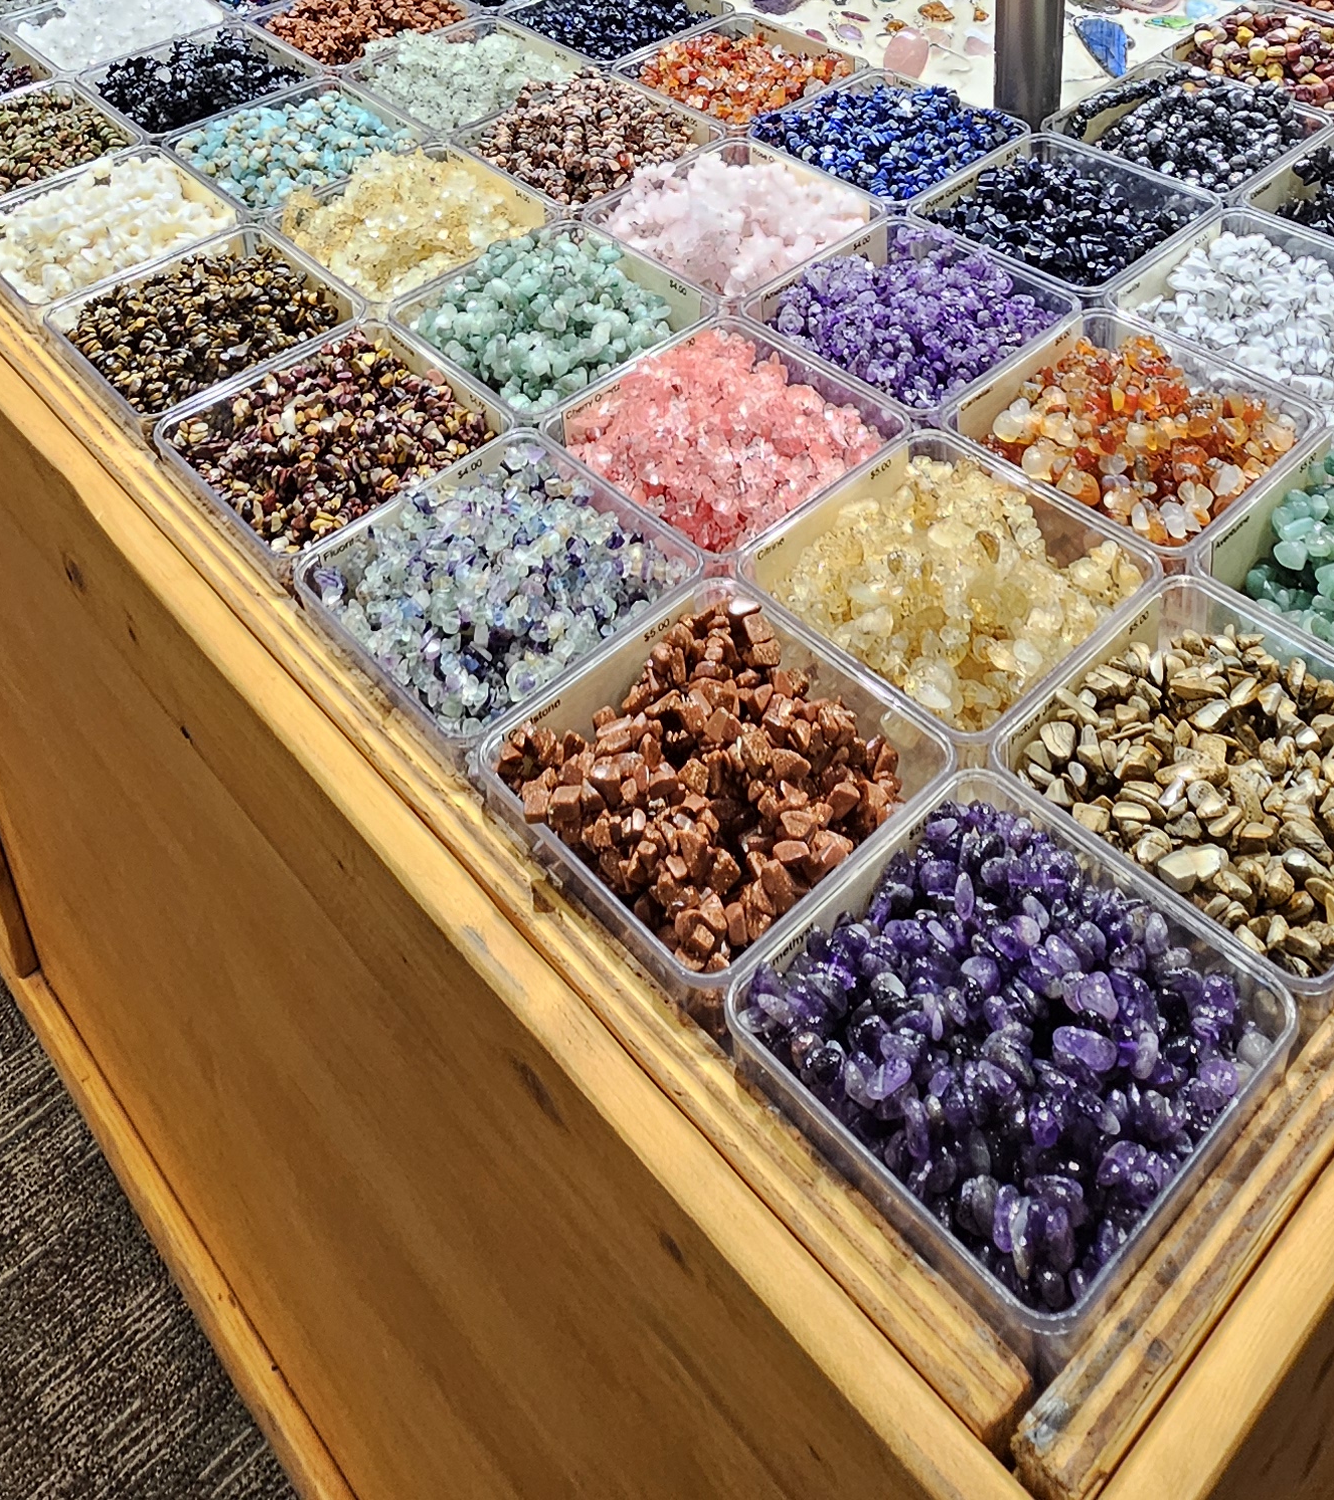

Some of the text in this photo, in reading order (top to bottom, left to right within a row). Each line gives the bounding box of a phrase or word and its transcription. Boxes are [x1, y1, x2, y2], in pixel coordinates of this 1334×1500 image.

[669, 280, 687, 296] $4.00
[566, 401, 593, 420] Cherry
[456, 459, 483, 480] $4.00
[870, 459, 892, 480] $5.00
[644, 618, 670, 642] $5.00
[1129, 610, 1150, 636] $5.00
[1011, 714, 1040, 745] Picture
